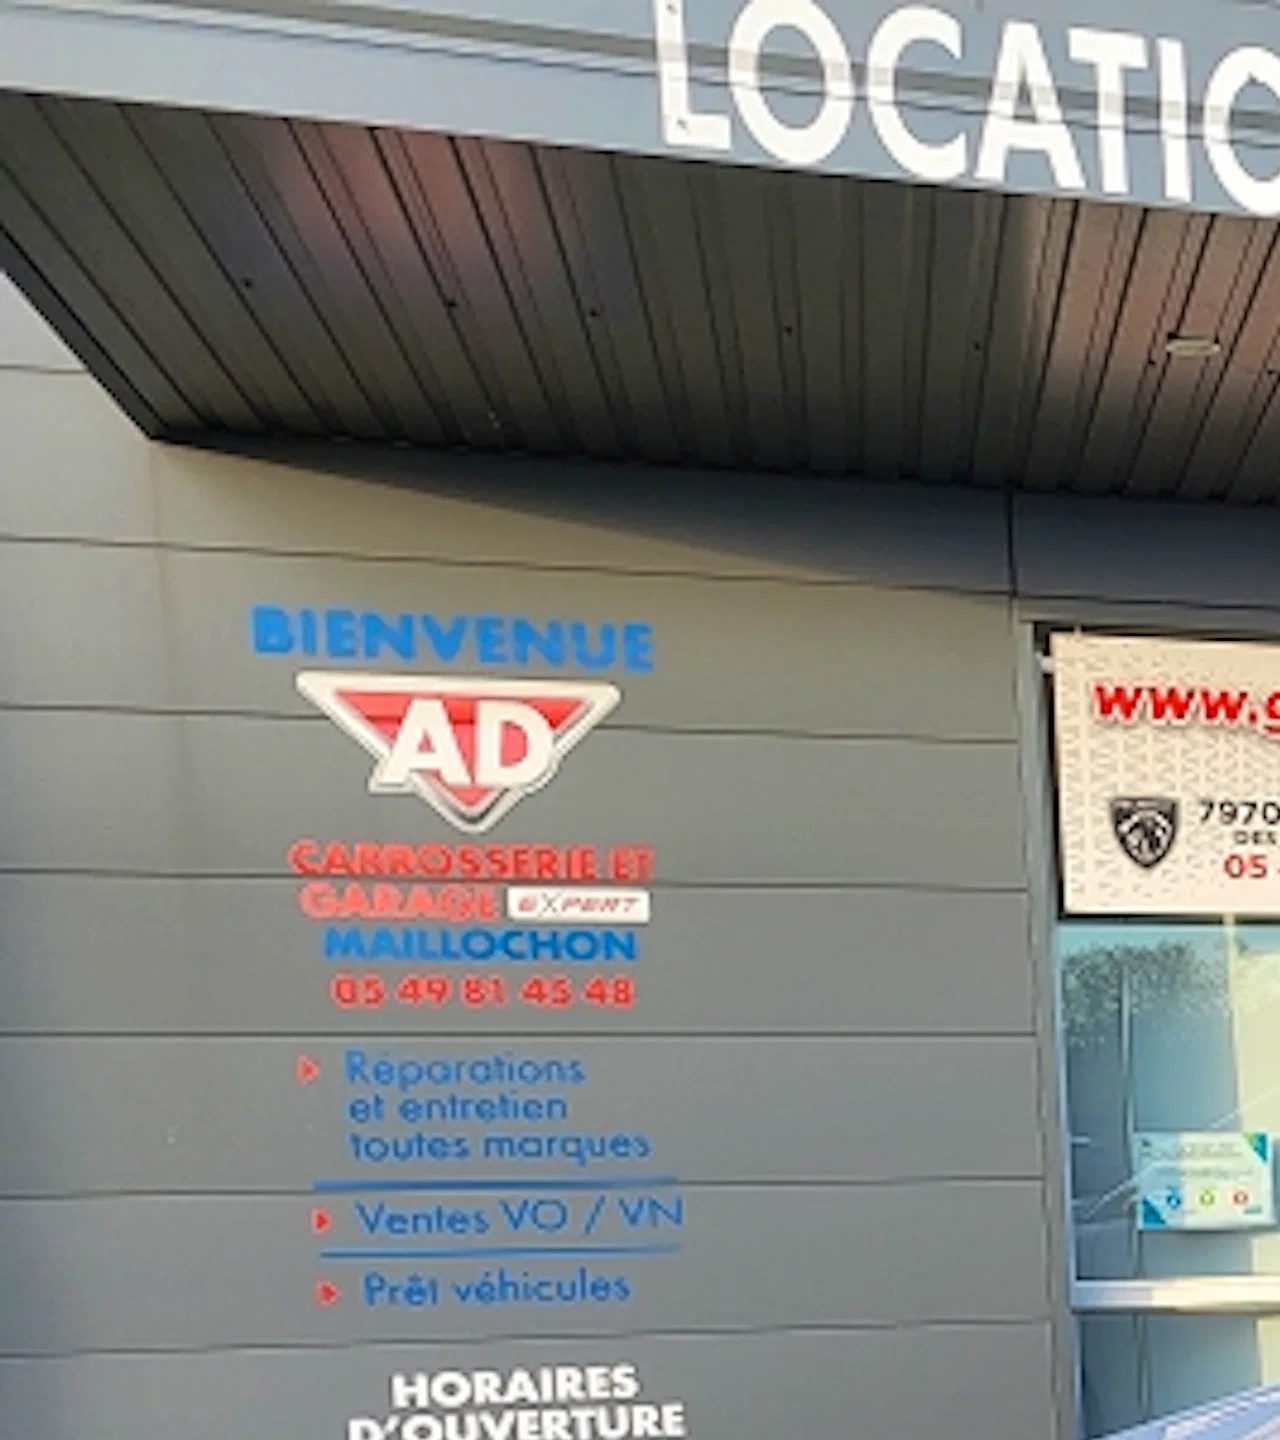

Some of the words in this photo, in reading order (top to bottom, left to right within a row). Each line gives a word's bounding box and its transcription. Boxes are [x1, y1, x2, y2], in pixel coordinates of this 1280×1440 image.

[252, 605, 655, 673] BIENVENUE
[370, 697, 557, 792] AD
[288, 840, 595, 881] CARROSSERIE
[608, 845, 654, 883] ET
[1224, 854, 1267, 879] 05
[301, 884, 498, 922] GARAGE
[322, 927, 638, 962] MAILLOCHON
[332, 975, 384, 1008] 05
[395, 975, 449, 1008] 49
[461, 975, 506, 1008] 81
[521, 975, 572, 1008] 45
[584, 975, 636, 1008] 48
[345, 1049, 585, 1092] Réparations
[349, 1094, 384, 1122] et
[399, 1092, 567, 1122] entretien
[349, 1132, 470, 1162] toutes
[483, 1133, 652, 1167] marques
[355, 1203, 489, 1236] Ventes
[500, 1199, 567, 1232] VO
[583, 1195, 607, 1236] /
[619, 1197, 683, 1229] VN
[363, 1273, 439, 1306] Prêt
[454, 1268, 630, 1304] véhicules
[391, 1364, 639, 1409] HORAIRES
